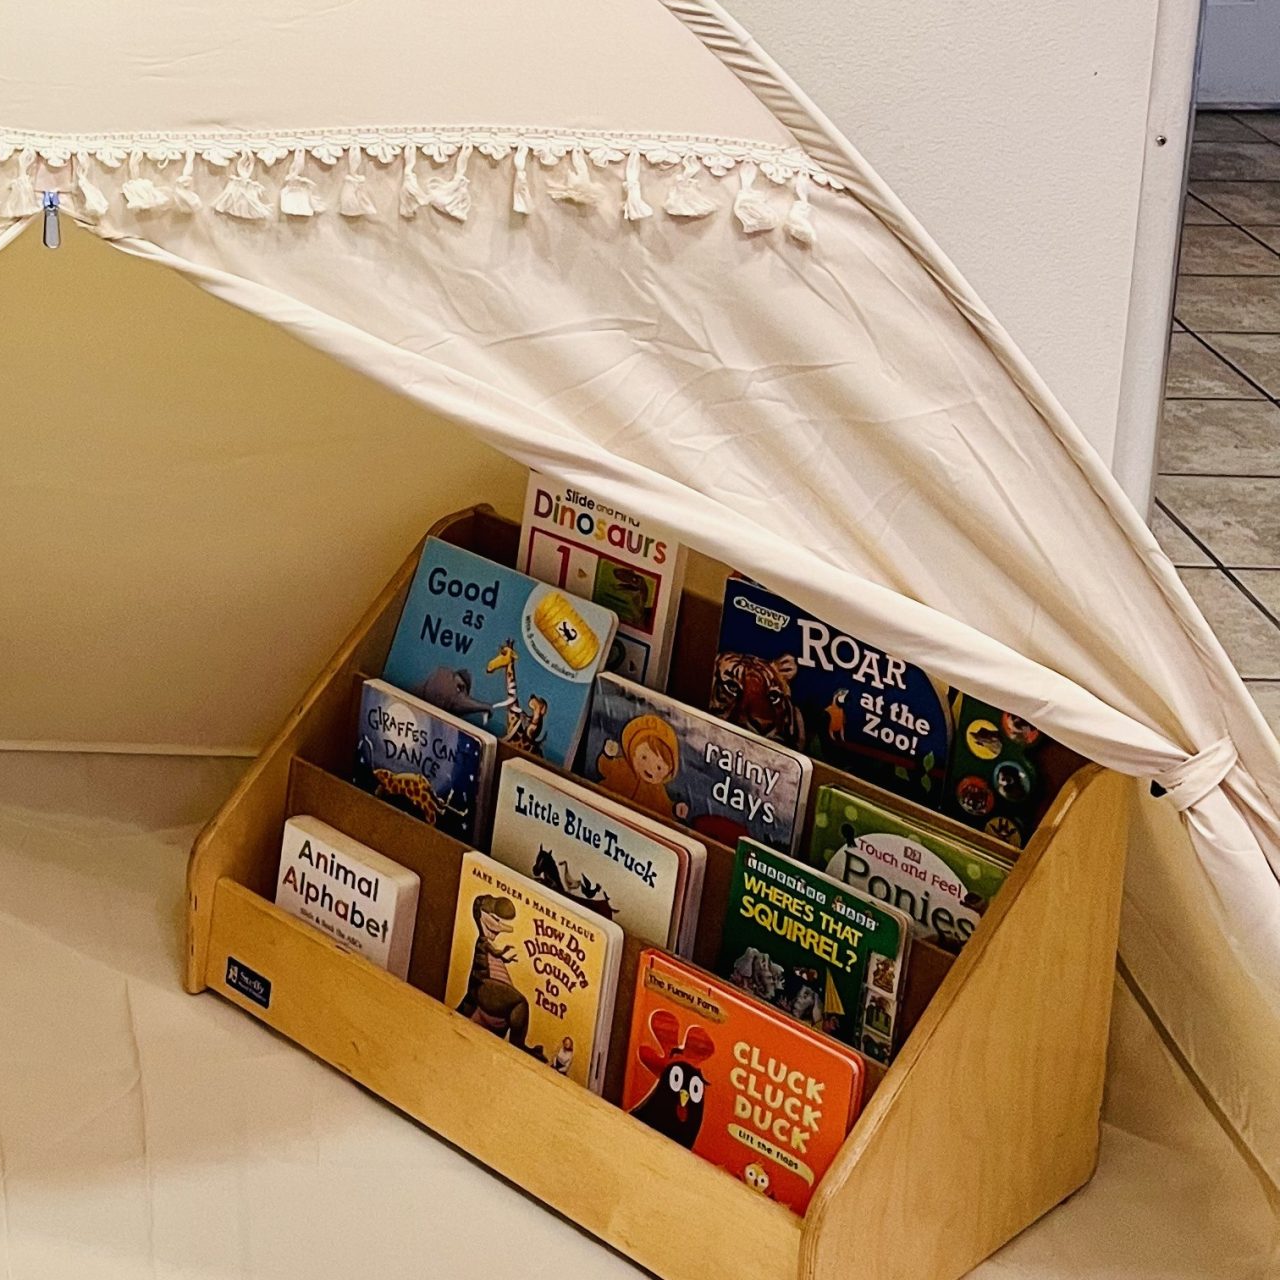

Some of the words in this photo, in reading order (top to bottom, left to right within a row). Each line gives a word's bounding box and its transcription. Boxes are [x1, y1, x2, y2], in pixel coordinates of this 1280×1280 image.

[565, 488, 595, 510] Slide
[533, 488, 667, 564] Dinosaurs
[428, 567, 500, 610] Good
[420, 614, 474, 655] New
[462, 609, 486, 630] as
[797, 618, 907, 690] ROAR
[368, 706, 428, 747] GIRAFFES
[432, 738, 459, 763] CAN
[860, 692, 885, 716] at
[890, 702, 931, 736] the
[862, 712, 919, 756] Zoo!
[384, 739, 440, 779] DANCE
[705, 742, 780, 796] rainy
[712, 776, 776, 824] days
[514, 785, 560, 827] Little
[564, 808, 602, 849] Blue
[604, 829, 658, 889] Truck
[298, 840, 379, 902] Animal
[858, 838, 899, 868] Touch
[900, 862, 928, 882] and
[931, 874, 962, 899] Feel
[282, 866, 389, 944] Alphabet
[744, 872, 814, 922] WHERE'S
[820, 911, 863, 948] THAT
[842, 850, 976, 941] Ponies
[532, 900, 558, 922] MARK
[560, 916, 596, 943] TEAGUE
[532, 918, 566, 944] How
[566, 934, 586, 962] Do
[740, 895, 858, 973] SQUIRREL?
[524, 938, 589, 989] Dinosaurs
[533, 956, 578, 994] Count
[546, 978, 560, 998] to
[534, 988, 568, 1020] Ten?
[648, 974, 665, 989] The
[667, 983, 695, 1004] Funny
[696, 996, 720, 1015] Farm
[733, 1041, 826, 1105] CLUCK
[730, 1066, 822, 1132] CLUCK
[734, 1094, 810, 1154] DUCK
[738, 1130, 754, 1145] Lift
[757, 1141, 773, 1154] the
[776, 1150, 800, 1171] flaps
